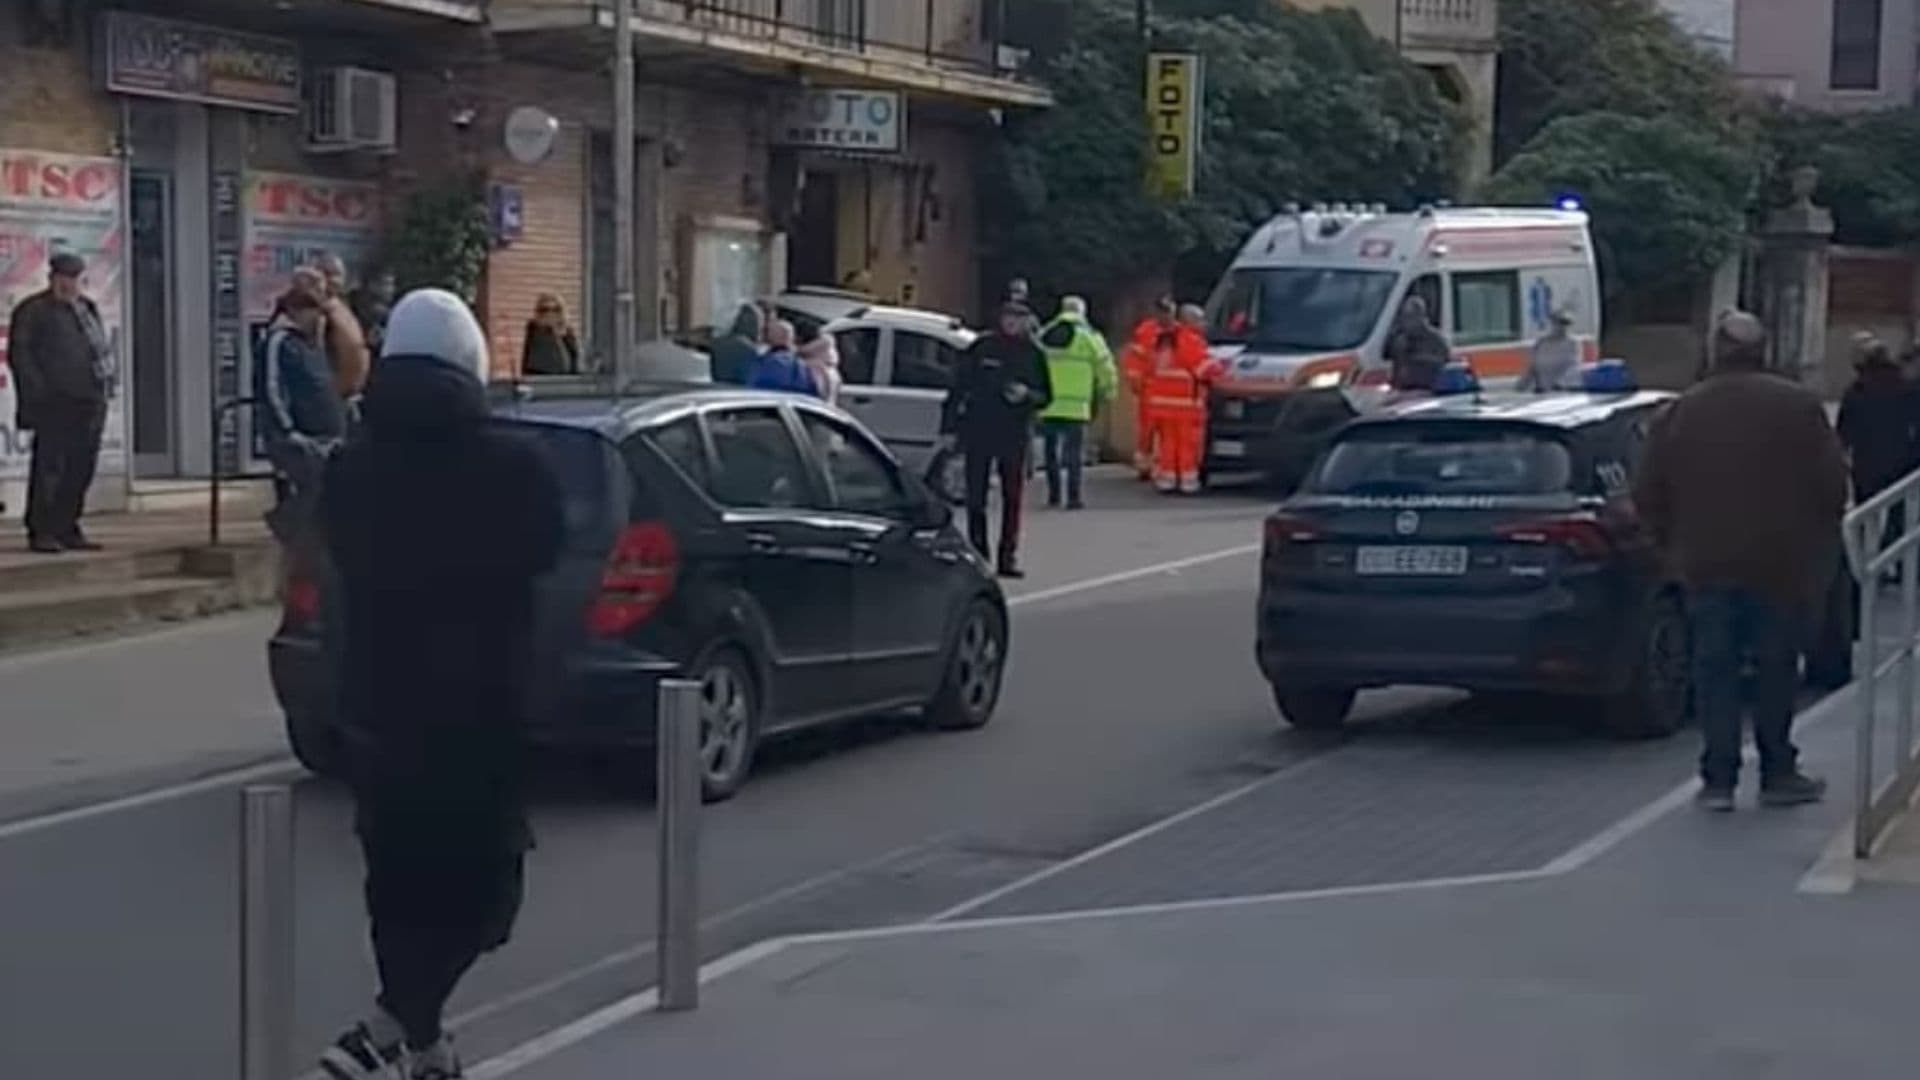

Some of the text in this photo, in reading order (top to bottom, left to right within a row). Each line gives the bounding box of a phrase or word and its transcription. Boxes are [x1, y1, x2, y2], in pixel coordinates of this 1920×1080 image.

[1159, 59, 1182, 155] FOTO
[3, 158, 106, 200] TSC
[258, 181, 367, 220] TSC
